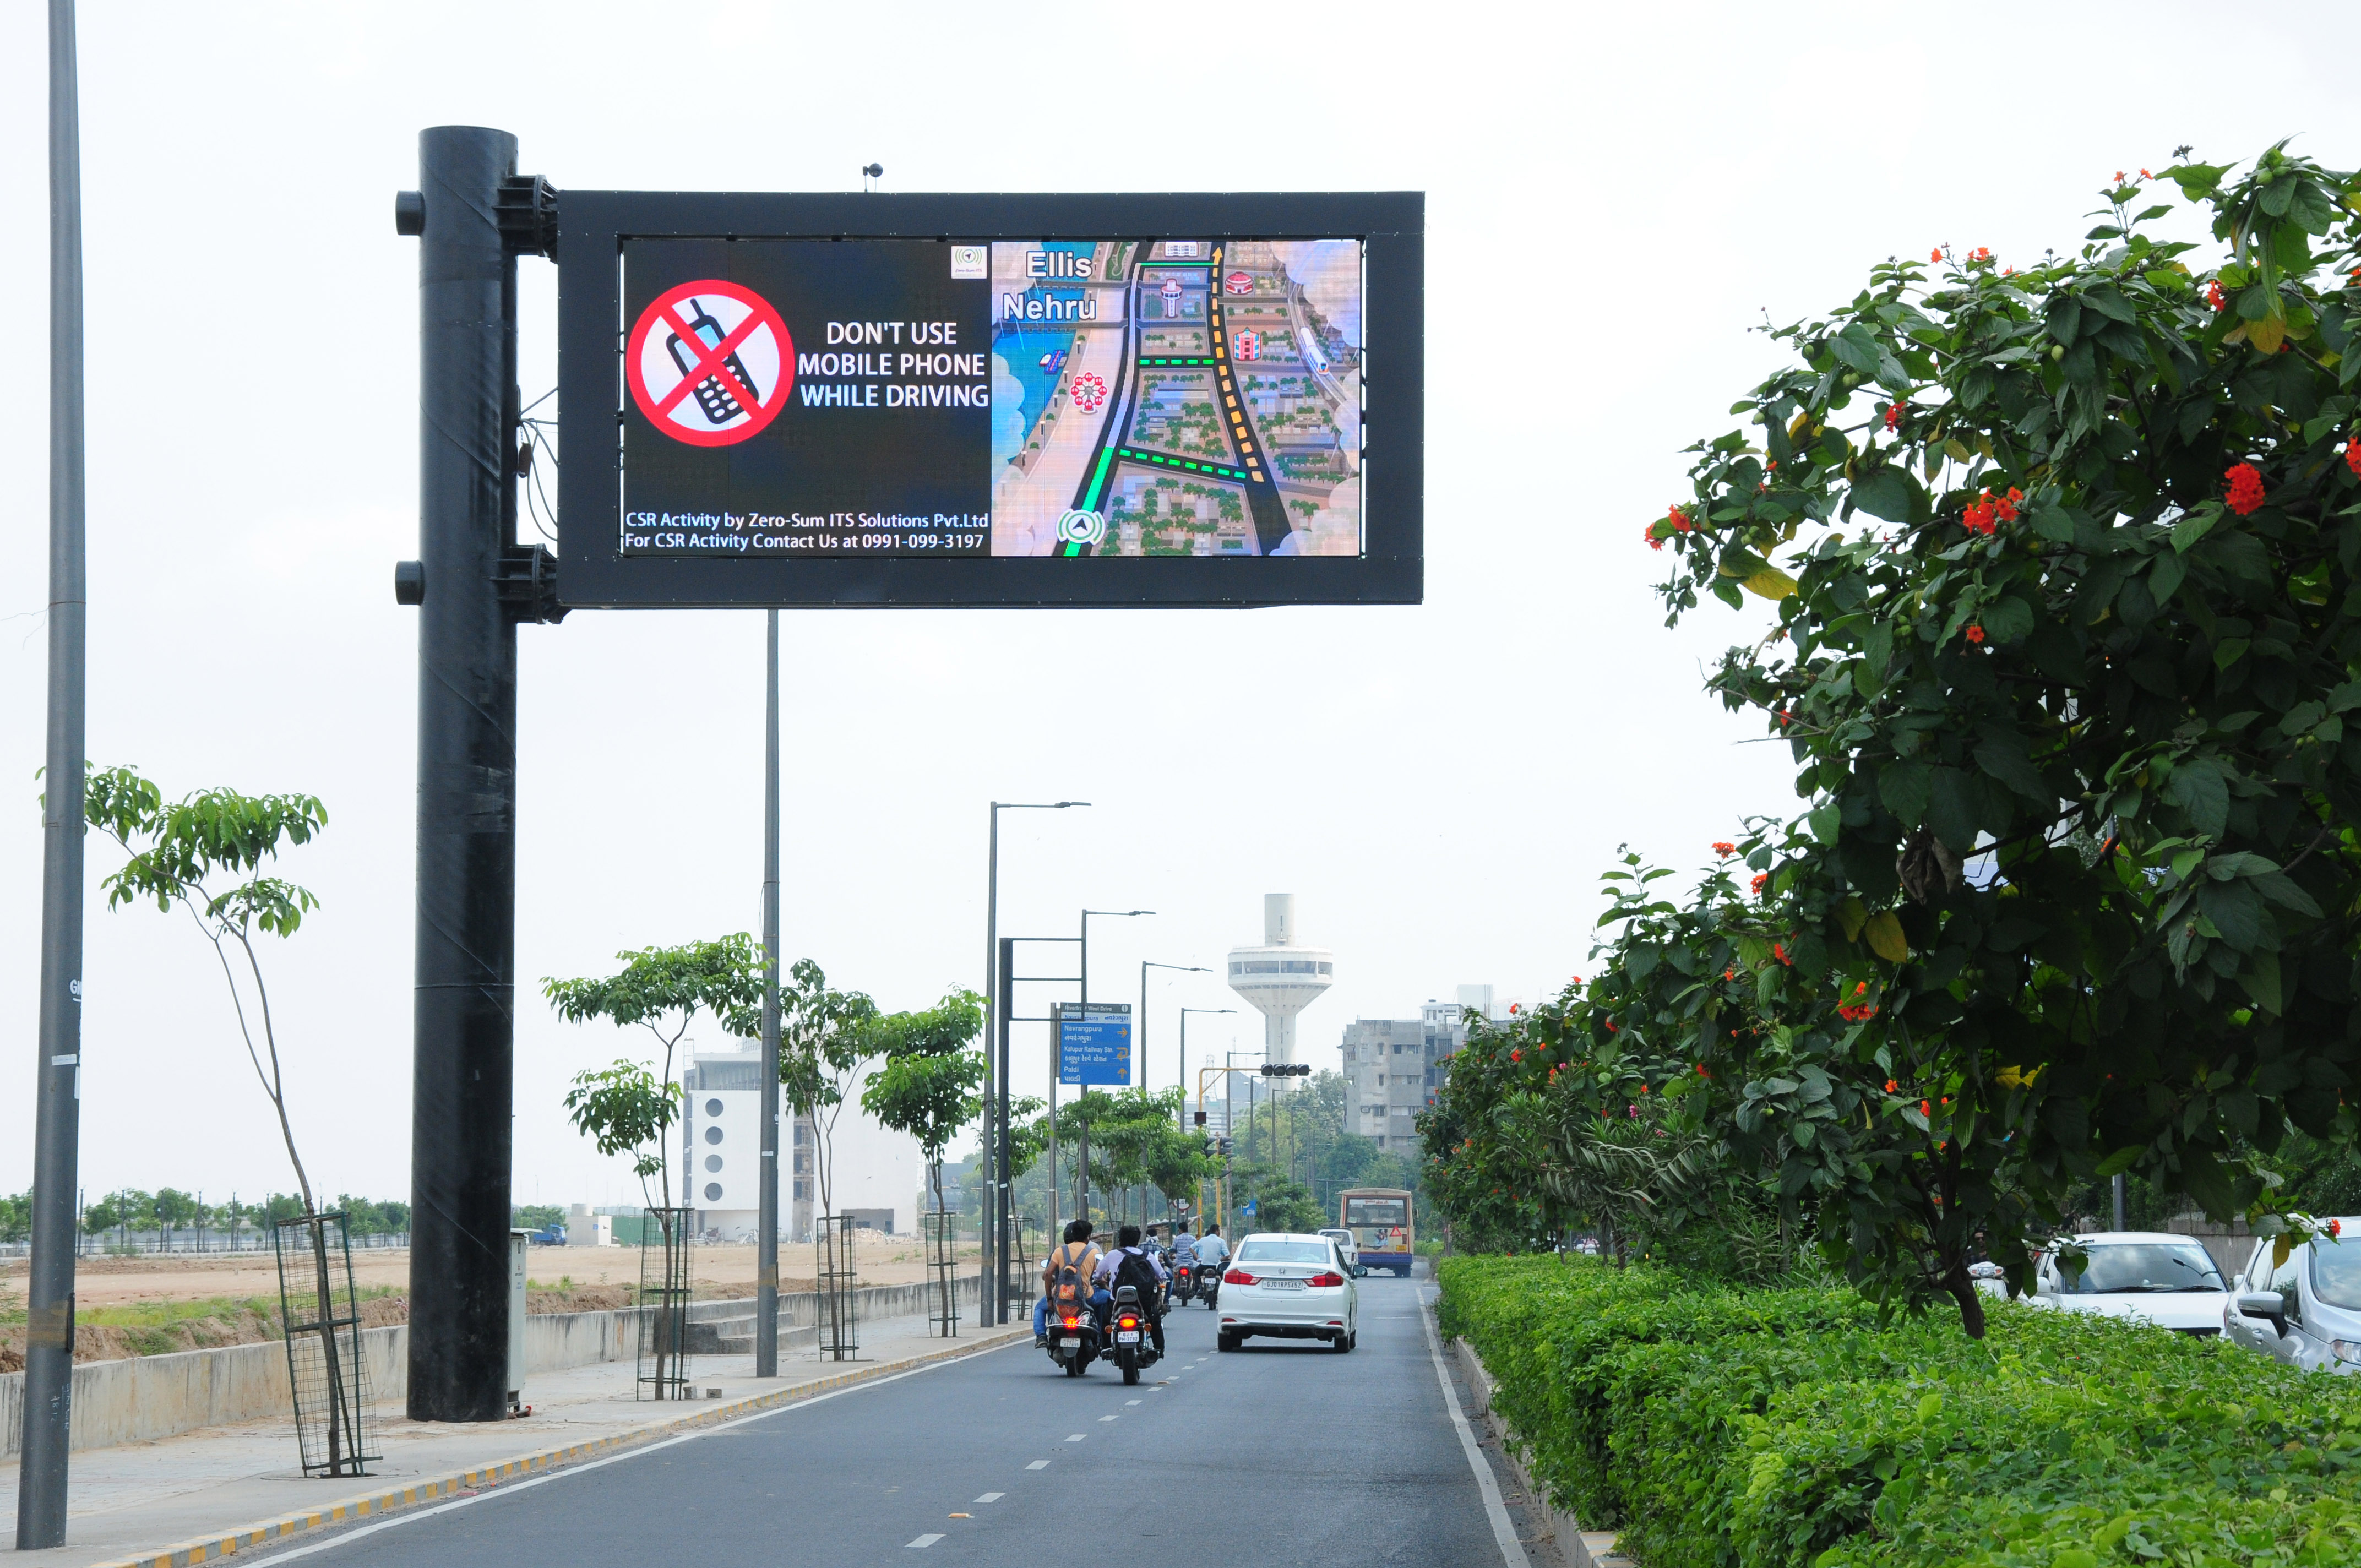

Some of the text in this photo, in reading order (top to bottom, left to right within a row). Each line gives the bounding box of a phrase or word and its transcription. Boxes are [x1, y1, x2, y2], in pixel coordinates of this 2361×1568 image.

[1026, 251, 1092, 277] Ellis
[1003, 293, 1096, 320] Nehru
[827, 322, 957, 344] DON'T USE
[798, 353, 985, 375] MOBILE PHONE
[800, 384, 988, 407] WHILE DRIVING
[625, 512, 989, 531] CSR Activity by Zero-Sum ITS Solutions Pvt.Ltd
[625, 533, 984, 552] For CSR Activity Contact Us at 0991-099-3197
[1064, 1025, 1102, 1033] Navrangpura
